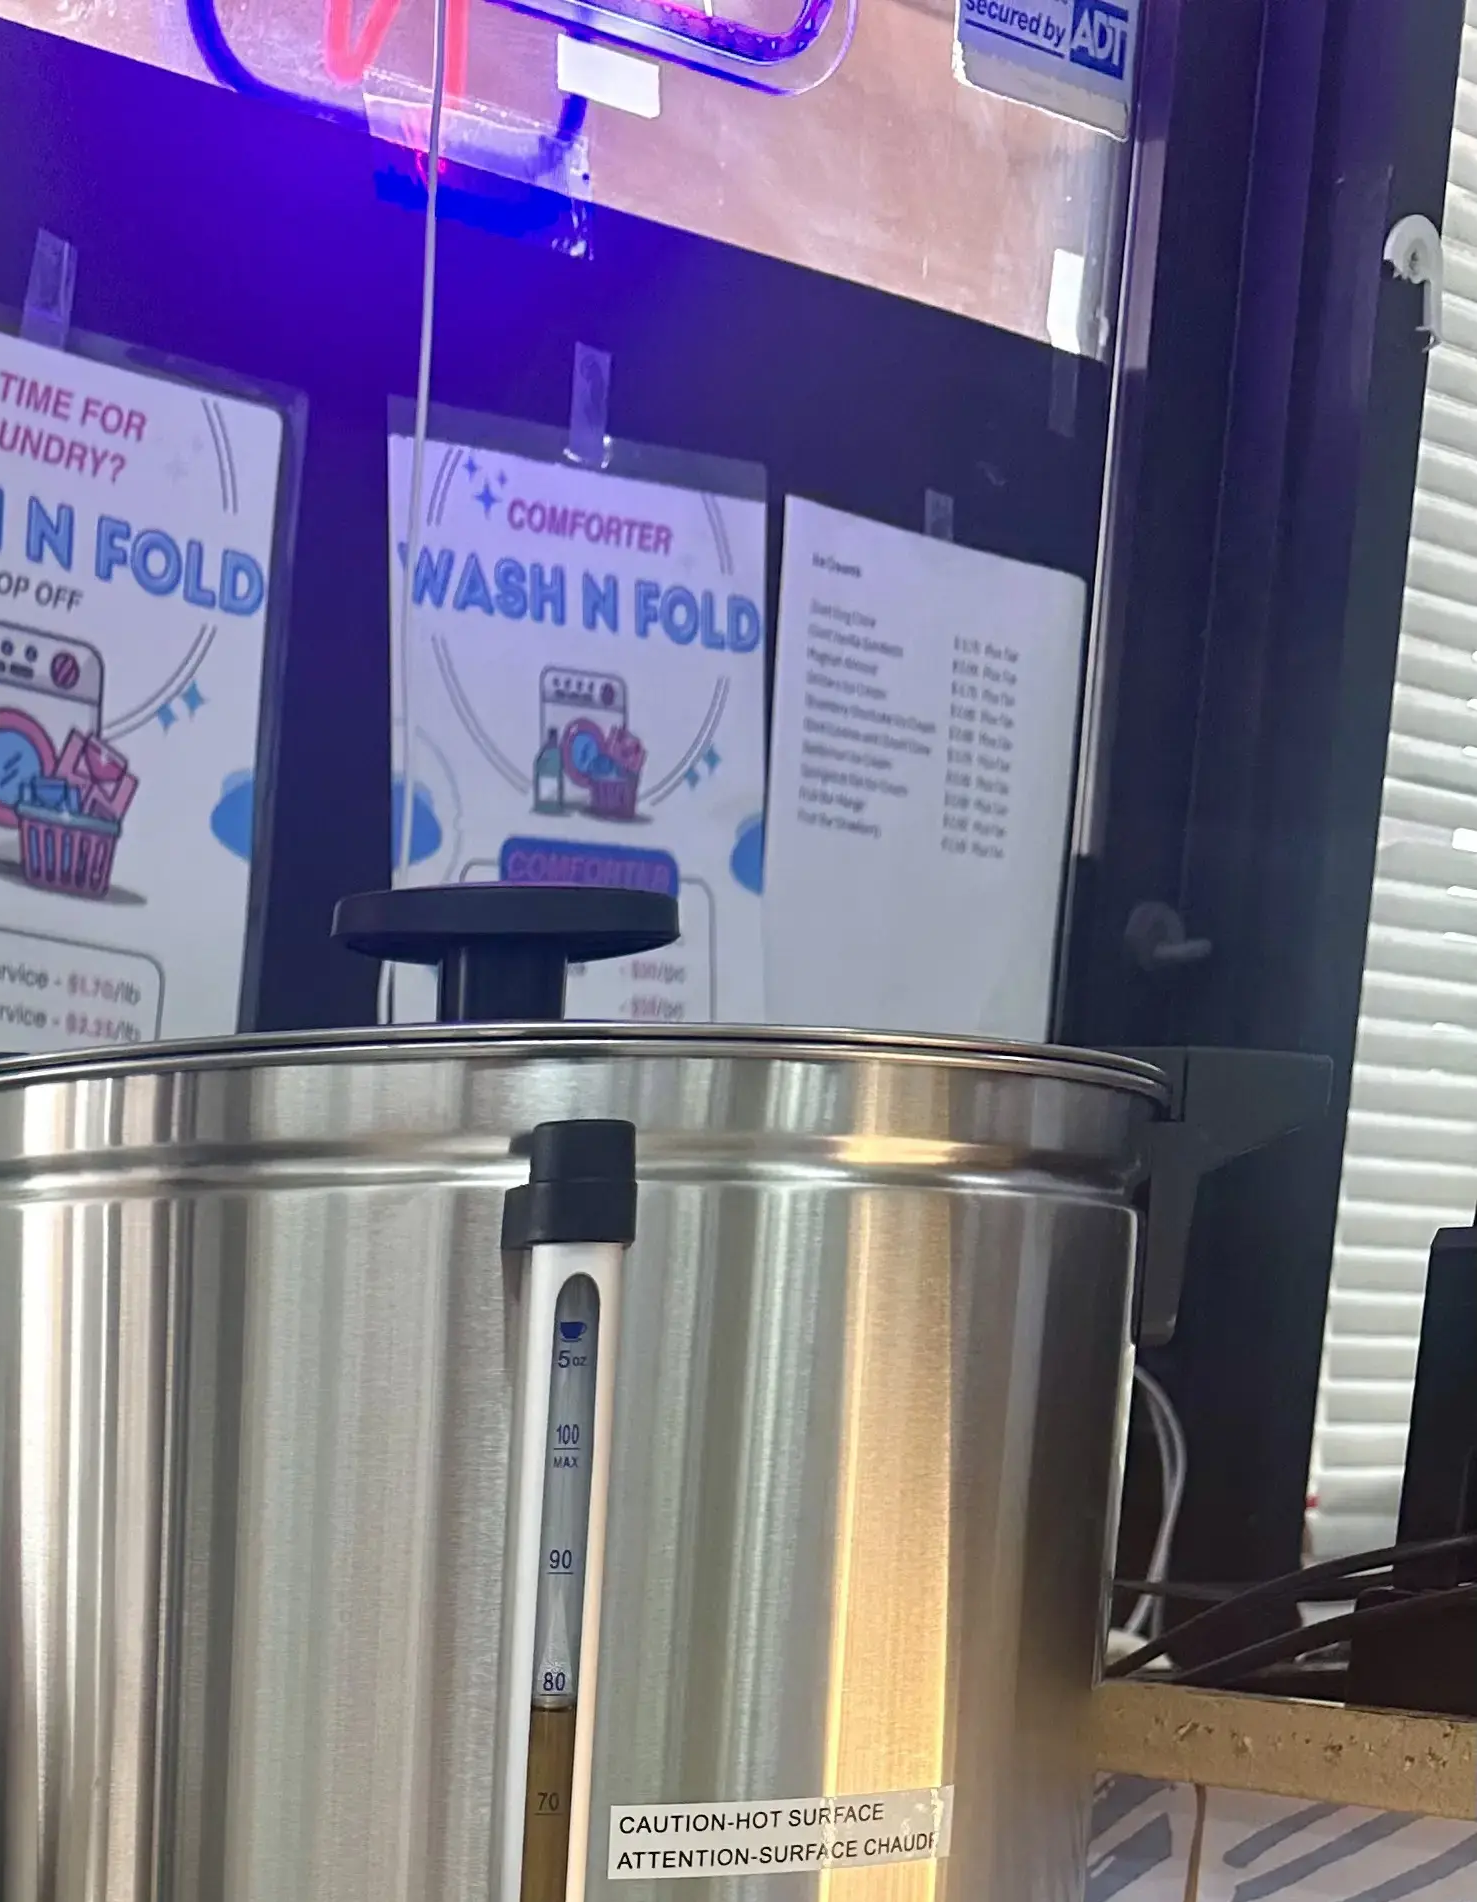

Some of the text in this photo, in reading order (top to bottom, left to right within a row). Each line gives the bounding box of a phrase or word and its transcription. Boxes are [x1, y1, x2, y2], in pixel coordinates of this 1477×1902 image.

[1043, 15, 1066, 48] by
[1073, 8, 1128, 67] ADT
[0, 371, 74, 423] TIME
[80, 403, 148, 443] FOR
[507, 498, 674, 556] COMFORTER
[25, 494, 74, 572] N
[94, 515, 265, 617] FOLD
[34, 580, 84, 614] OFF
[398, 541, 566, 628] WASH
[581, 567, 619, 634] N
[634, 581, 762, 655] FOLD
[555, 1425, 580, 1446] 100
[553, 1456, 580, 1469] MAX
[549, 1549, 573, 1570] 90
[542, 1672, 567, 1692] 80
[537, 1791, 560, 1812] 70
[619, 1803, 885, 1835] CAUTION-HOT SURFACE
[617, 1839, 858, 1871] ATTENTION-SURFACE
